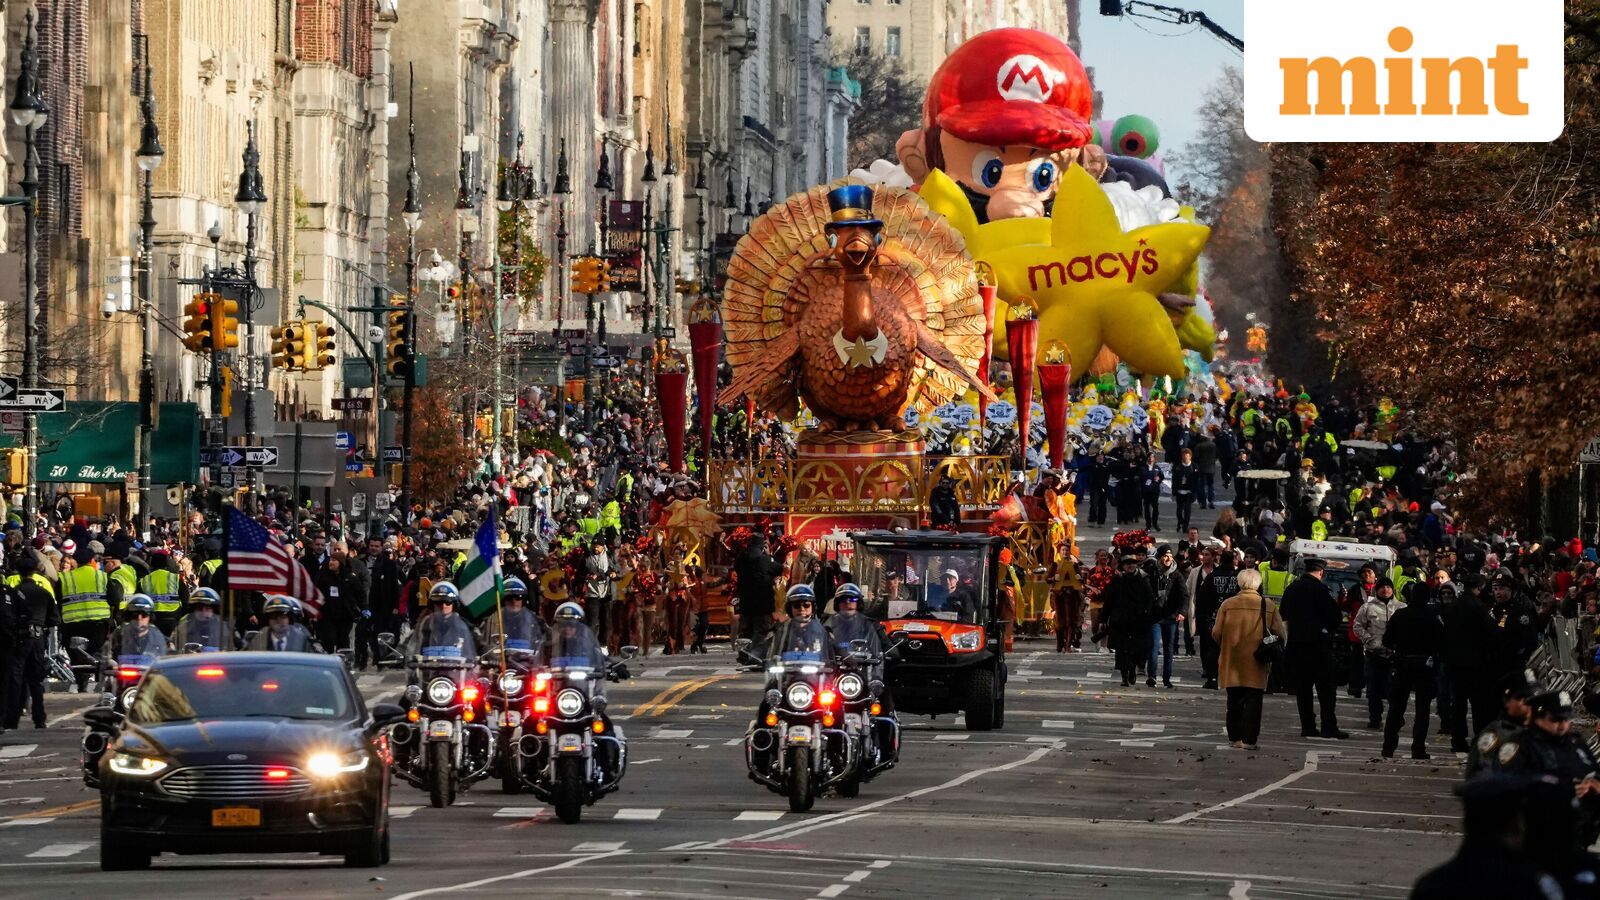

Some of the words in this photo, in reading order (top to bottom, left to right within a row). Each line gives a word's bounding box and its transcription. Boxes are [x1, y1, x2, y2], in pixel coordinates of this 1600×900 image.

[1001, 62, 1050, 96] M
[34, 396, 54, 405] WAY
[252, 452, 271, 460] WAY
[49, 465, 68, 477] 50
[78, 465, 101, 479] The
